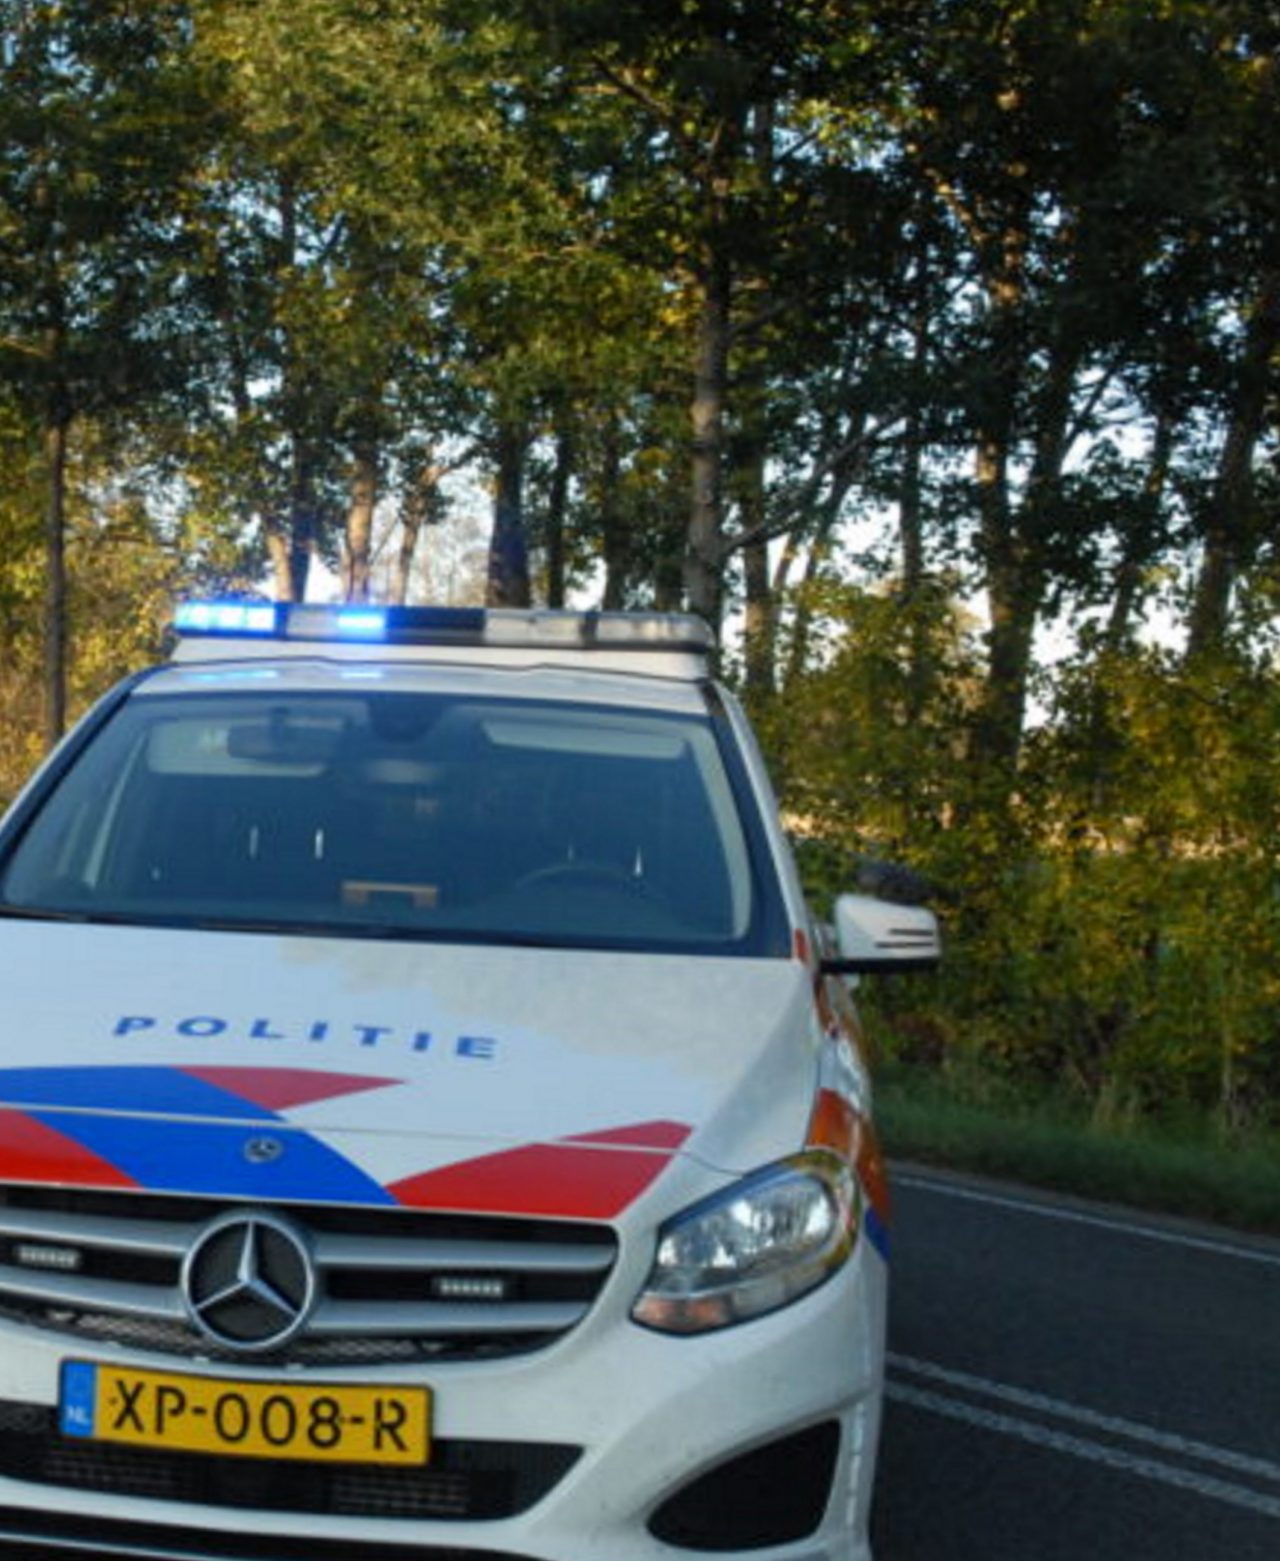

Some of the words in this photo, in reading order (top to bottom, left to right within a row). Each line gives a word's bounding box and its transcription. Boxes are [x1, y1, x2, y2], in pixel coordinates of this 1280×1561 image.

[113, 1015, 498, 1059] POLITIE
[65, 1404, 90, 1426] NL
[113, 1379, 407, 1452] XP-008-R
